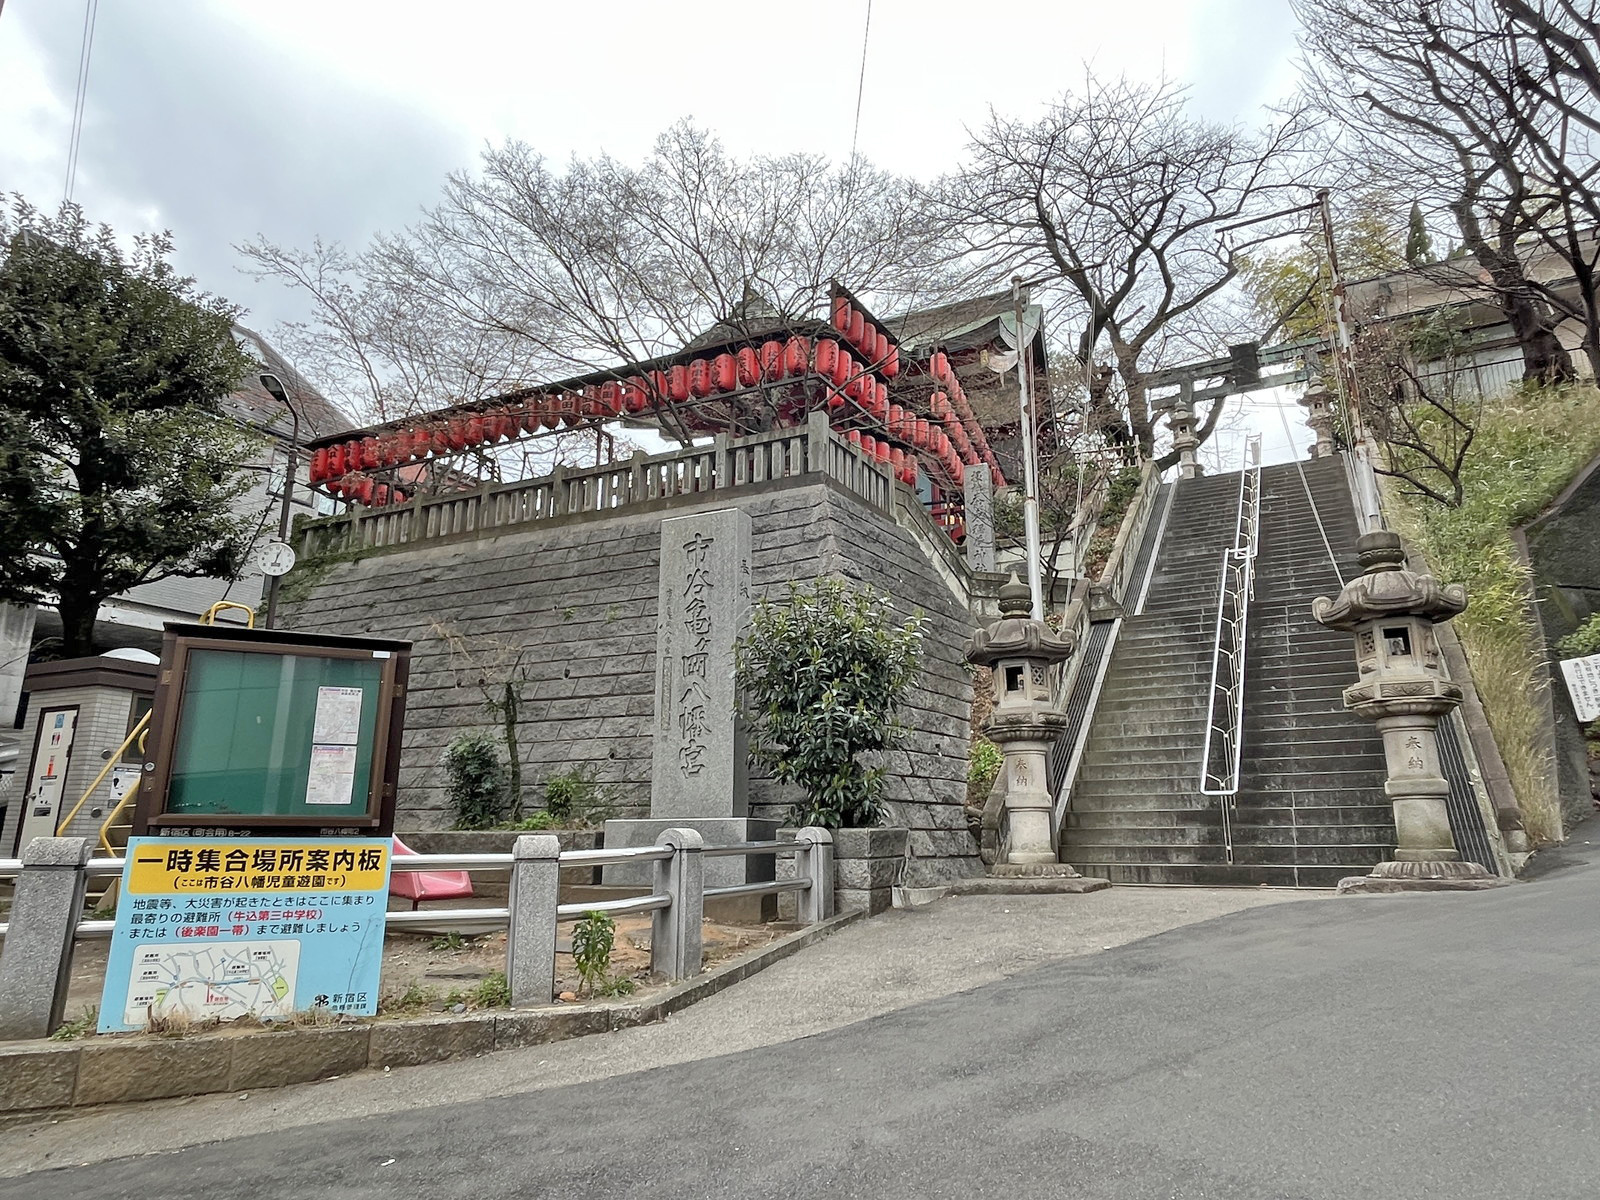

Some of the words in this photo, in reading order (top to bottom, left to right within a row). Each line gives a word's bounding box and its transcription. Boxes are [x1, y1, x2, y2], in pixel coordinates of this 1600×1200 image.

[1405, 735, 1424, 770] 奉納
[1015, 757, 1028, 787] 奉納
[136, 848, 383, 873] 一時集合場所案内板
[173, 874, 347, 890] (ここは市谷八幡児童遊園です)
[132, 894, 375, 911] 地震等、大災害が起きたときはここに集まり
[332, 992, 368, 1003] 新宿区
